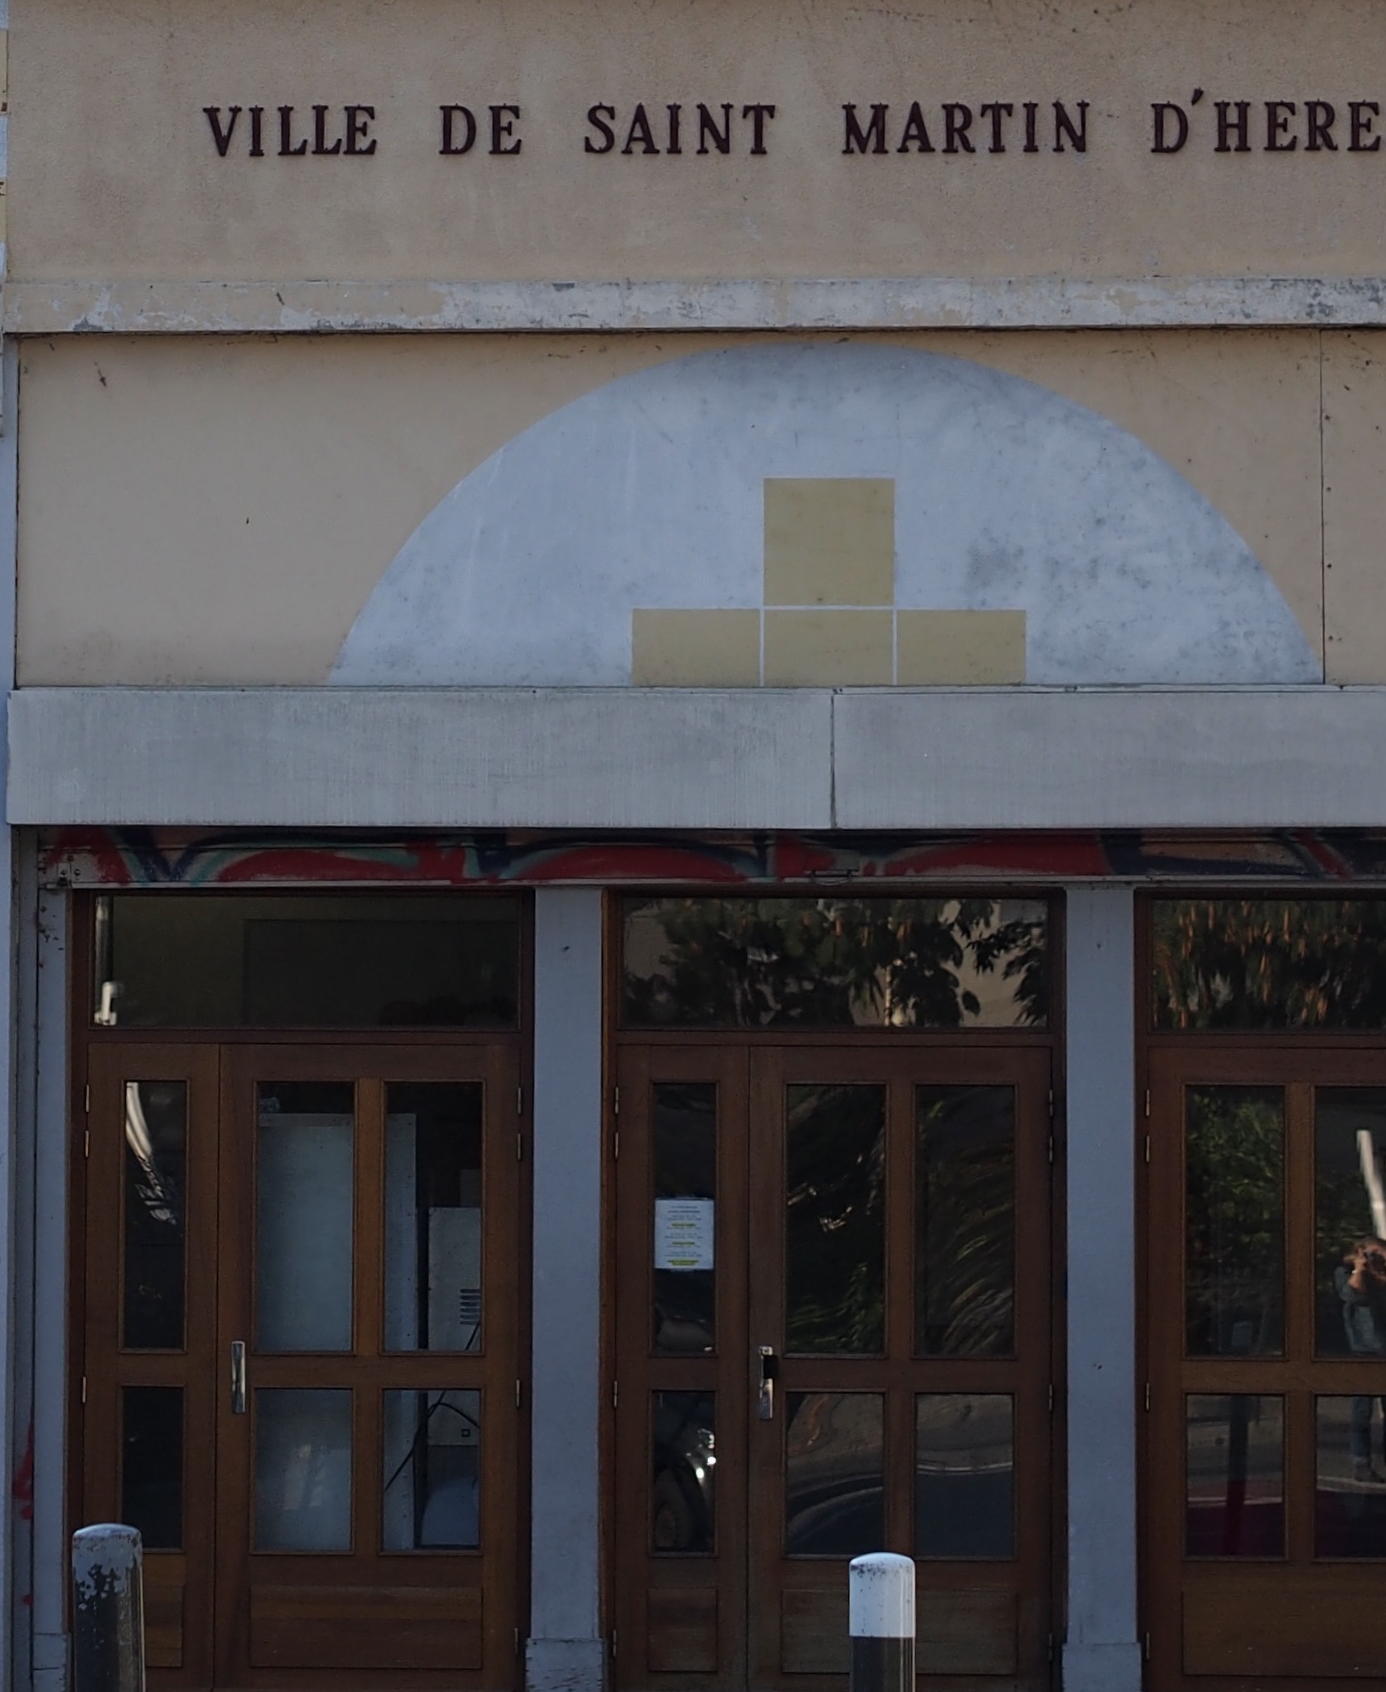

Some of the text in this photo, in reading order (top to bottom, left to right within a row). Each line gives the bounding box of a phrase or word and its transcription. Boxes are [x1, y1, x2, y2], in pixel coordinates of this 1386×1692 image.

[203, 105, 377, 157] VILLE
[439, 104, 523, 155] DE
[584, 103, 776, 155] SAINT
[841, 101, 1091, 155] MARTIN
